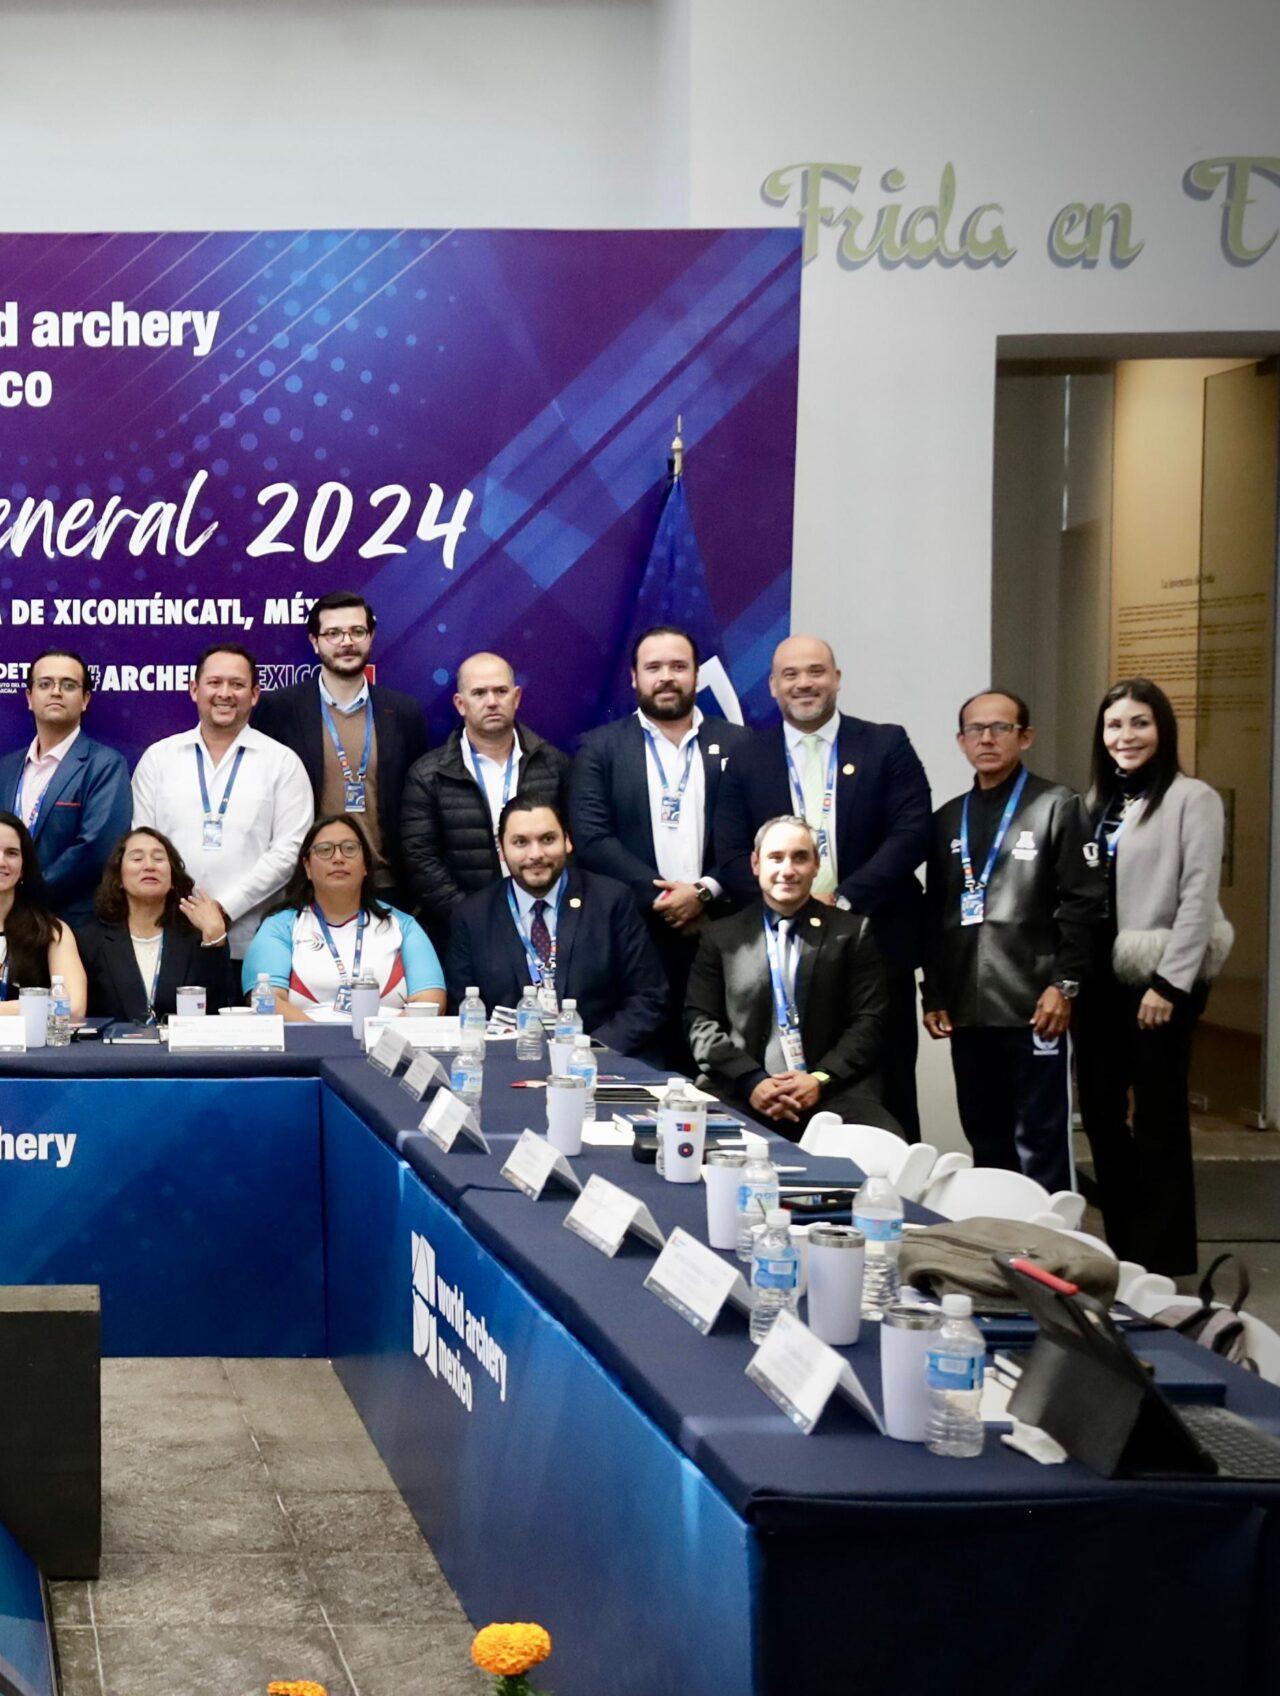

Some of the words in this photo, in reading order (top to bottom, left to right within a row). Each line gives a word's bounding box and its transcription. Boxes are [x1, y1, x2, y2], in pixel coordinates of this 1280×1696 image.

[761, 160, 1018, 271] Frida
[1047, 200, 1146, 270] en
[31, 301, 221, 357] archery
[245, 481, 475, 570] 2024
[11, 599, 46, 626] DE
[53, 592, 255, 631] XICOHTÉNCATL,
[436, 1274, 465, 1340] world
[465, 1308, 508, 1402] archery
[437, 1335, 474, 1412] mexico
